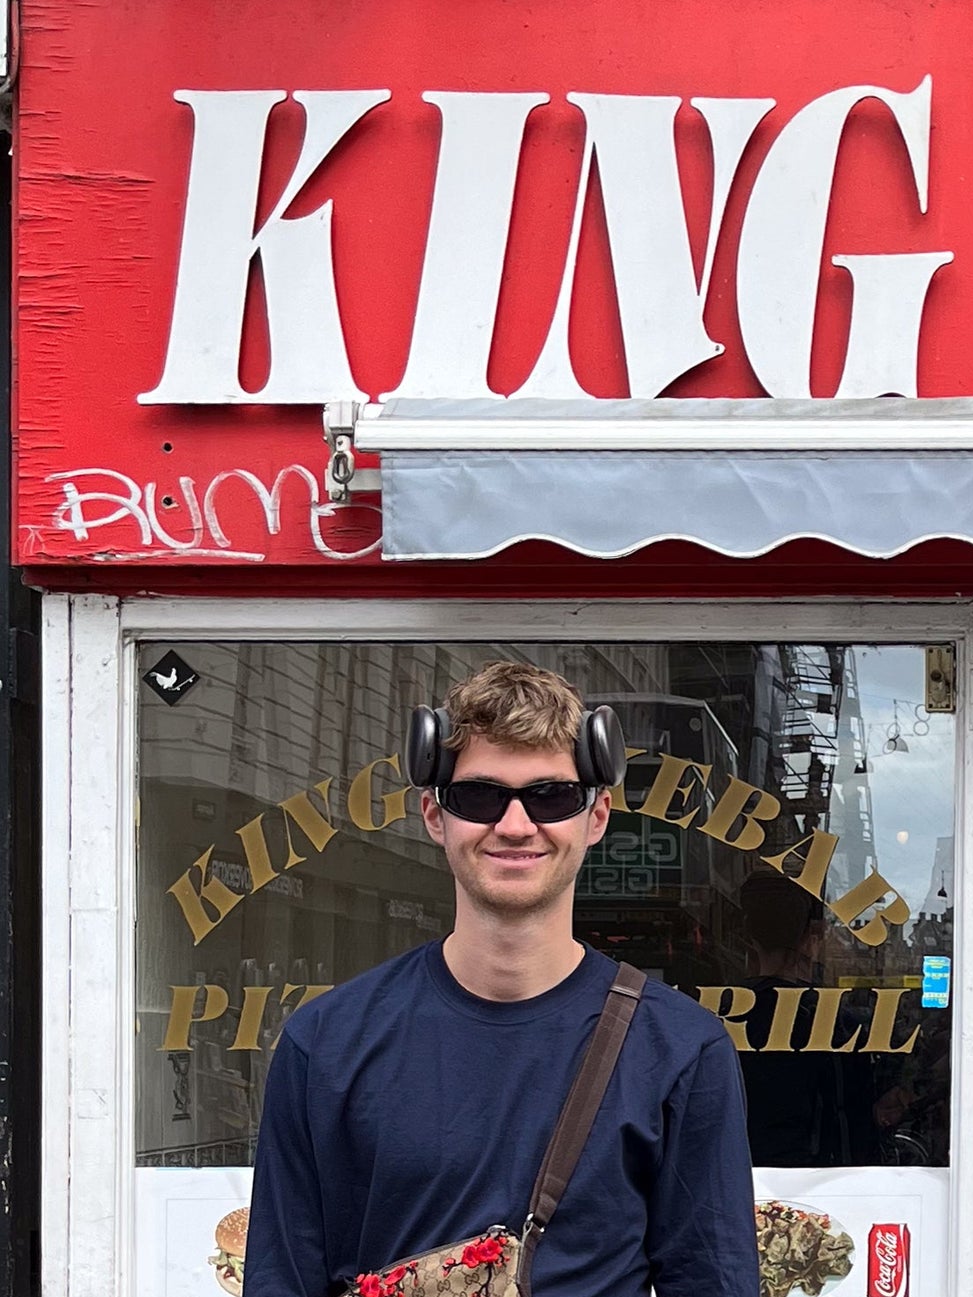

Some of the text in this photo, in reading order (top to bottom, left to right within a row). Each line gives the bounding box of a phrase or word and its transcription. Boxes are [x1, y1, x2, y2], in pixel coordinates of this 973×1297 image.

[136, 73, 955, 406] KING
[164, 752, 414, 948] KING
[672, 985, 922, 1054] RILL
